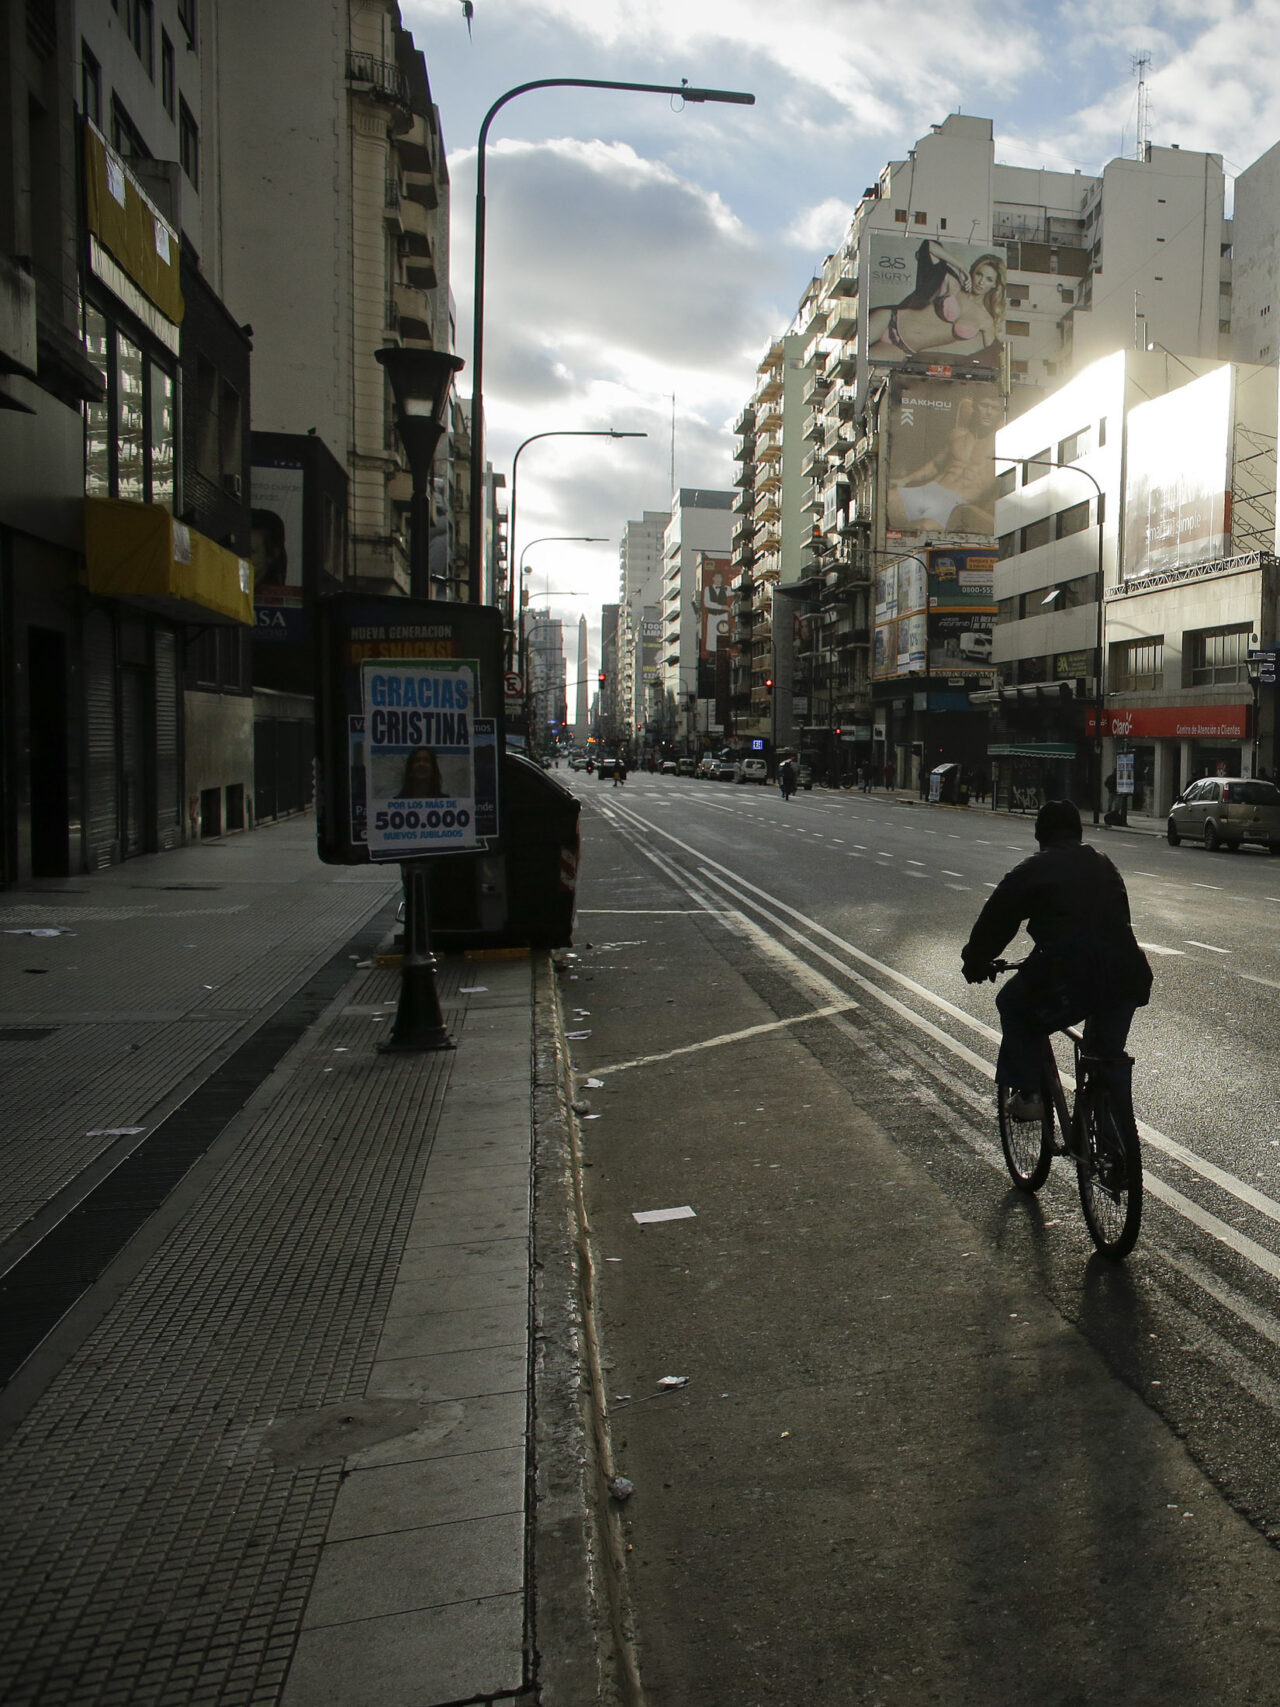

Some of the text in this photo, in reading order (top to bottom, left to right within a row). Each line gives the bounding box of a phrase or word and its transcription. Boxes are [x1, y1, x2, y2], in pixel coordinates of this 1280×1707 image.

[351, 624, 453, 640] NUEVA GENERACION
[371, 675, 469, 710] GRACIAS
[372, 710, 469, 745] CRISTINA
[1112, 718, 1131, 735] Claro
[1221, 724, 1241, 735] Clientes
[387, 801, 406, 809] POR
[407, 801, 423, 809] LOS
[446, 800, 457, 809] DE
[375, 809, 470, 830] 500.000
[384, 829, 463, 840] NUEVOS JUBILADOS
